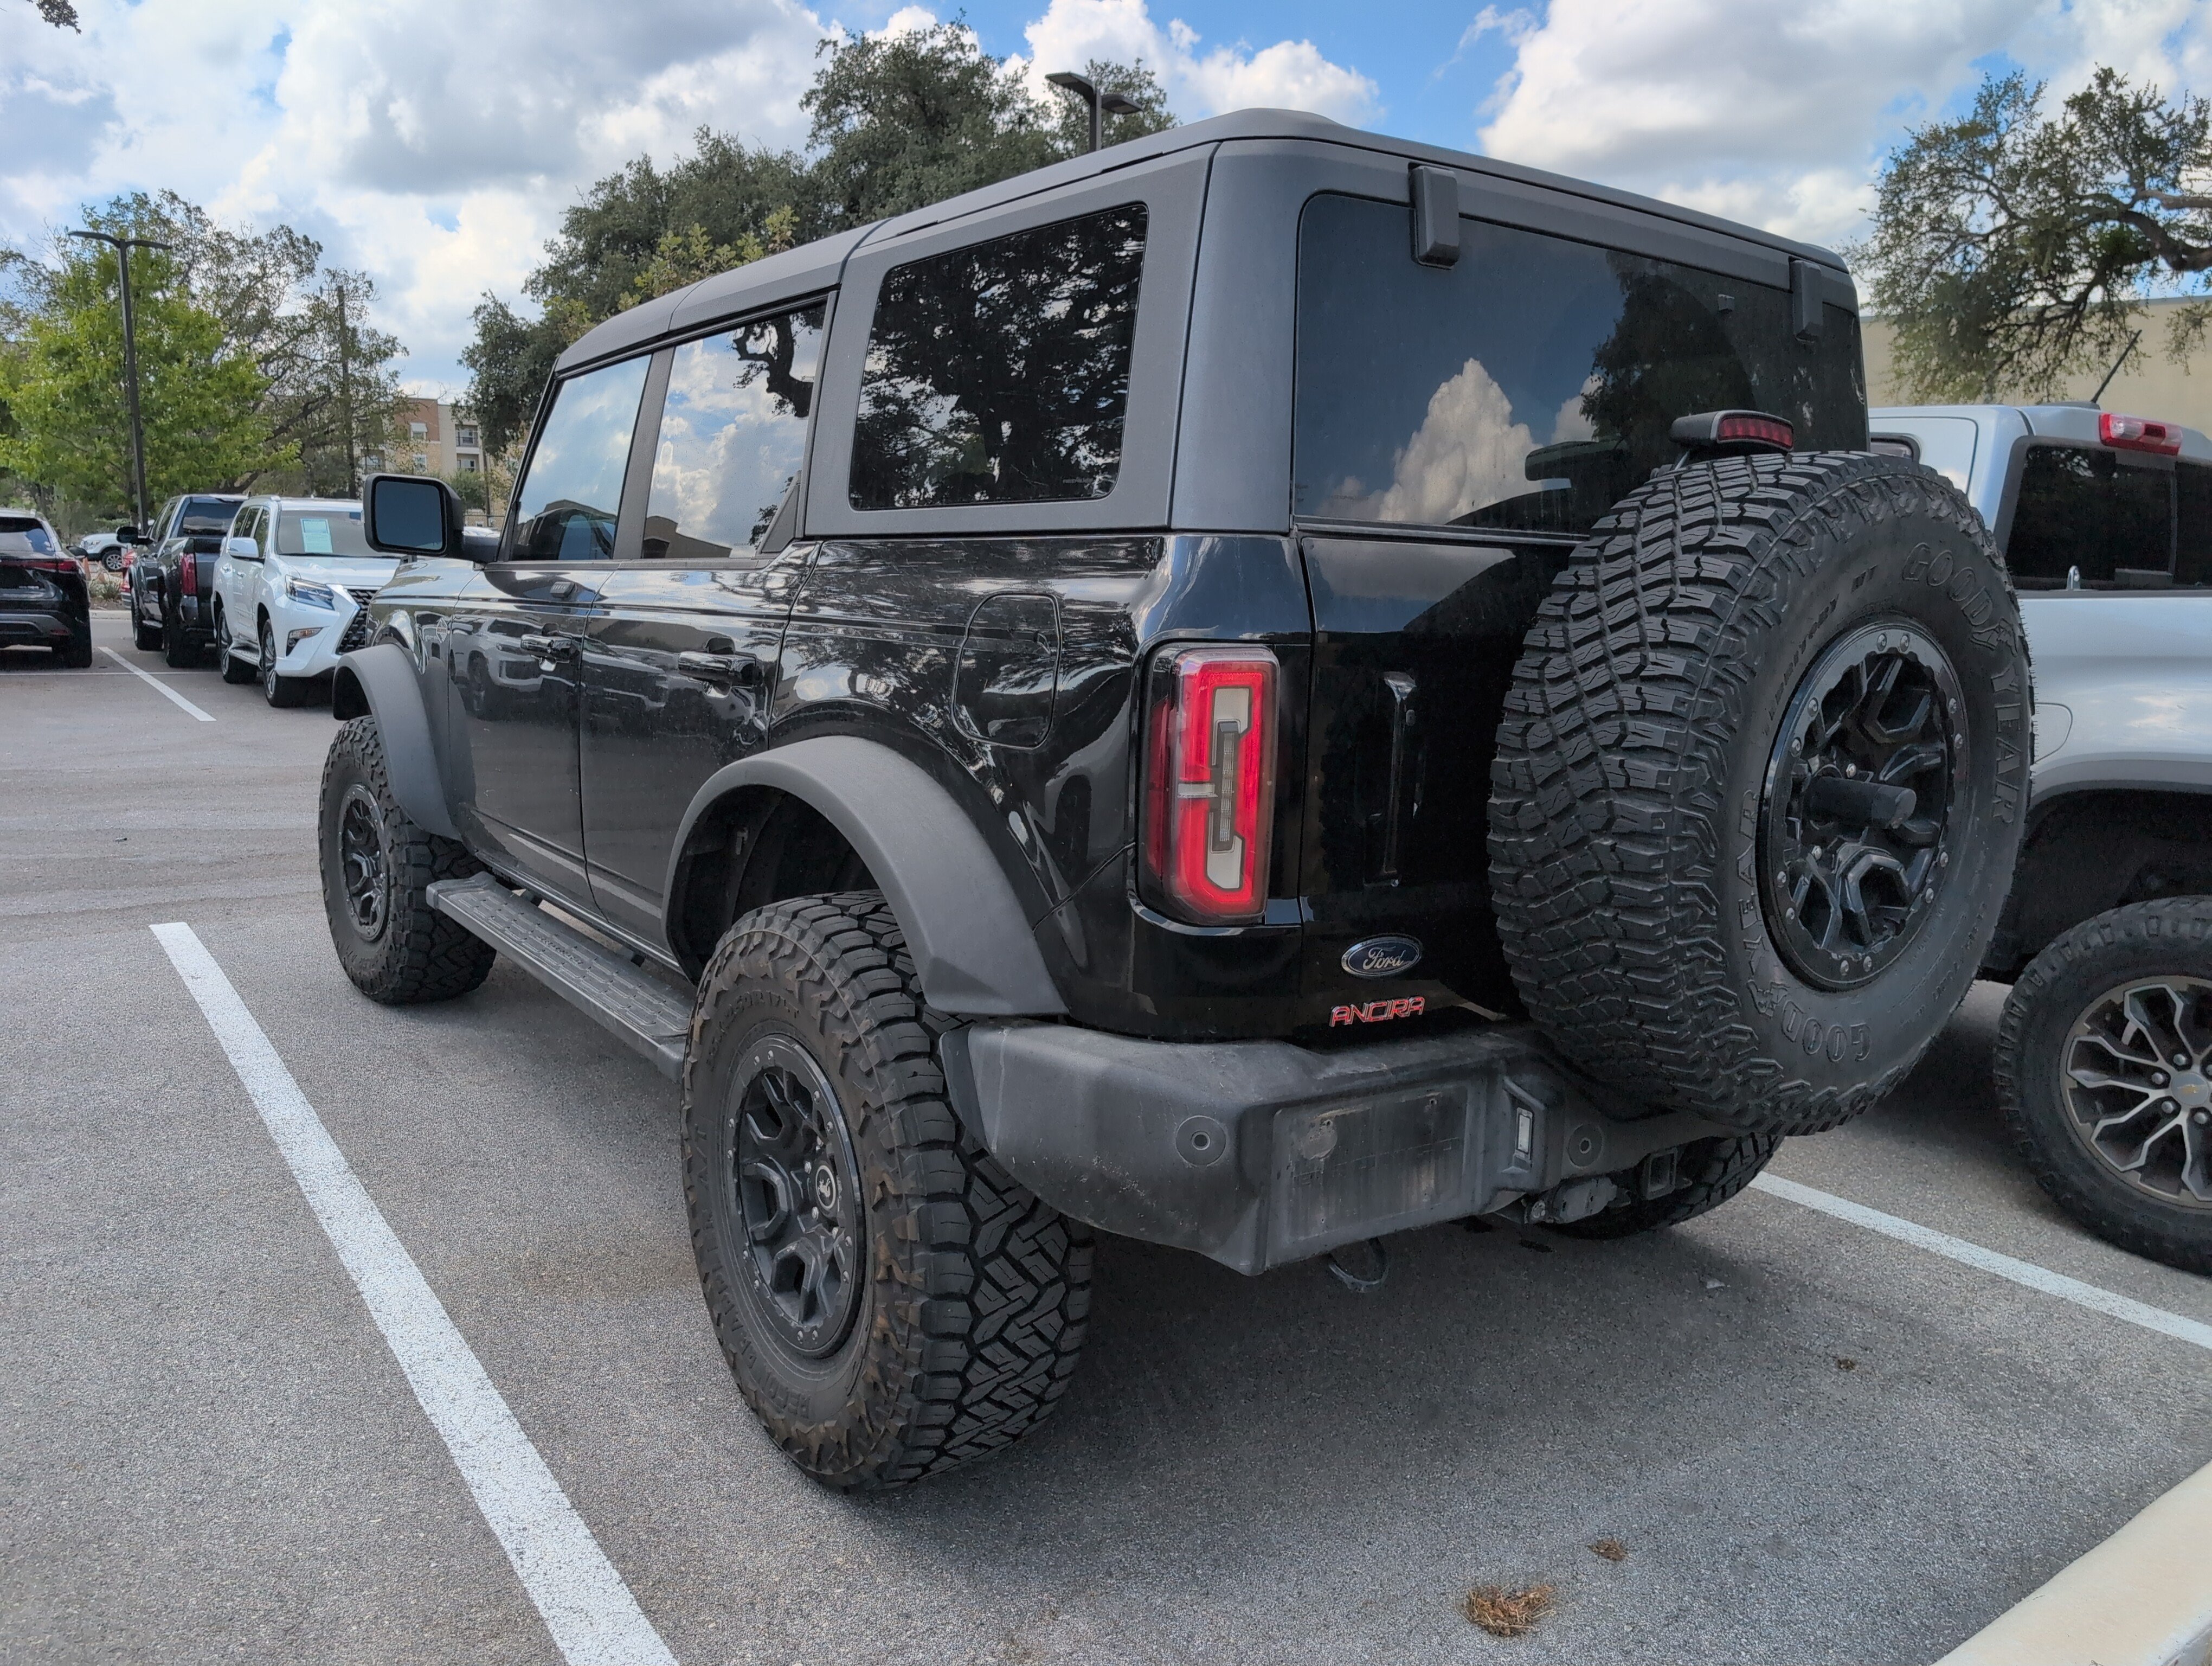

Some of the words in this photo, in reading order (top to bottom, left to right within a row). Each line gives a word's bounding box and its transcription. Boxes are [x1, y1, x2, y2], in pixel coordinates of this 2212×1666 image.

[1901, 542, 2021, 823] GOODYEAR
[1362, 946, 1408, 970] Ford
[1737, 790, 1872, 1062] GOODYEAR
[1329, 996, 1425, 1027] ANCIRA
